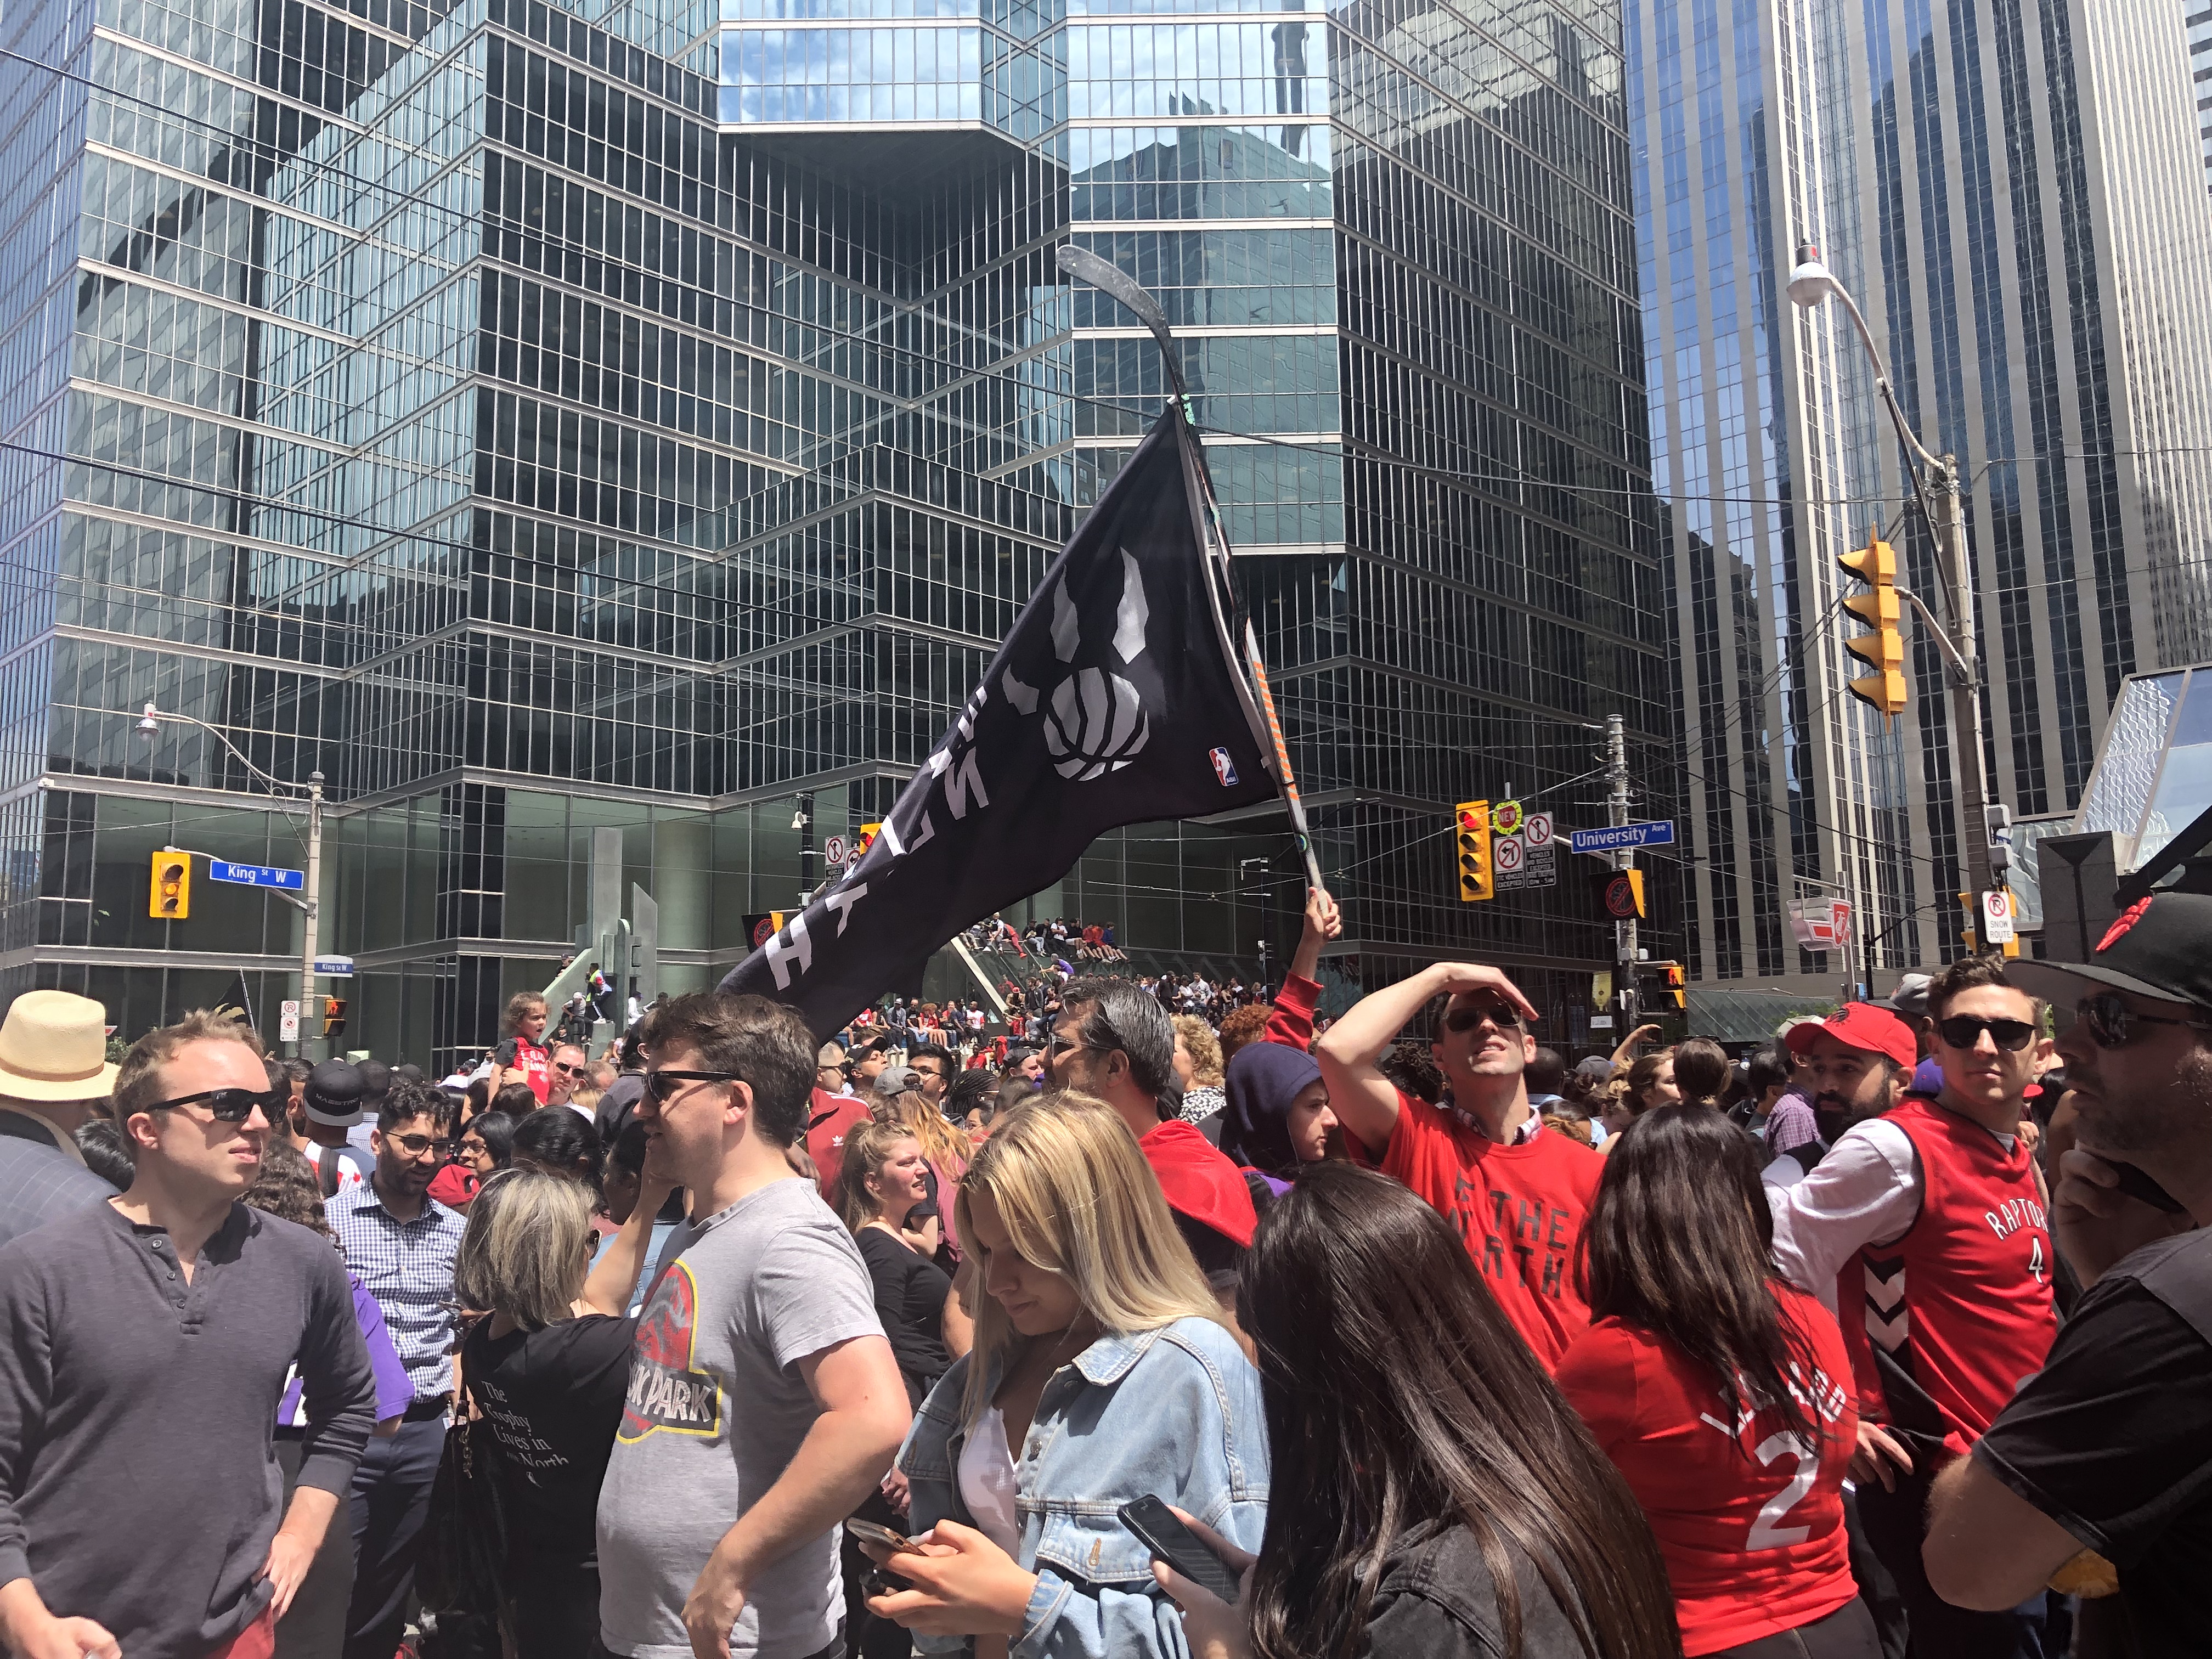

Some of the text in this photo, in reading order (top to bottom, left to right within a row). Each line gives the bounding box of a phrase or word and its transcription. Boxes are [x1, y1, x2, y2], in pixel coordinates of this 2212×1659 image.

[1499, 810, 1516, 822] NEW
[1576, 827, 1646, 847] University
[228, 865, 256, 883] King
[275, 871, 286, 883] W
[1980, 943, 1988, 952] 2
[322, 963, 335, 972] King
[1489, 1190, 1570, 1250] THE
[1447, 1206, 1565, 1299] NRTH
[2028, 1237, 2043, 1283] 4
[481, 1380, 507, 1403] The
[641, 1367, 712, 1423] PARK
[484, 1402, 532, 1432] Trophy
[493, 1424, 552, 1450] Lives in
[1745, 1430, 1820, 1551] 2
